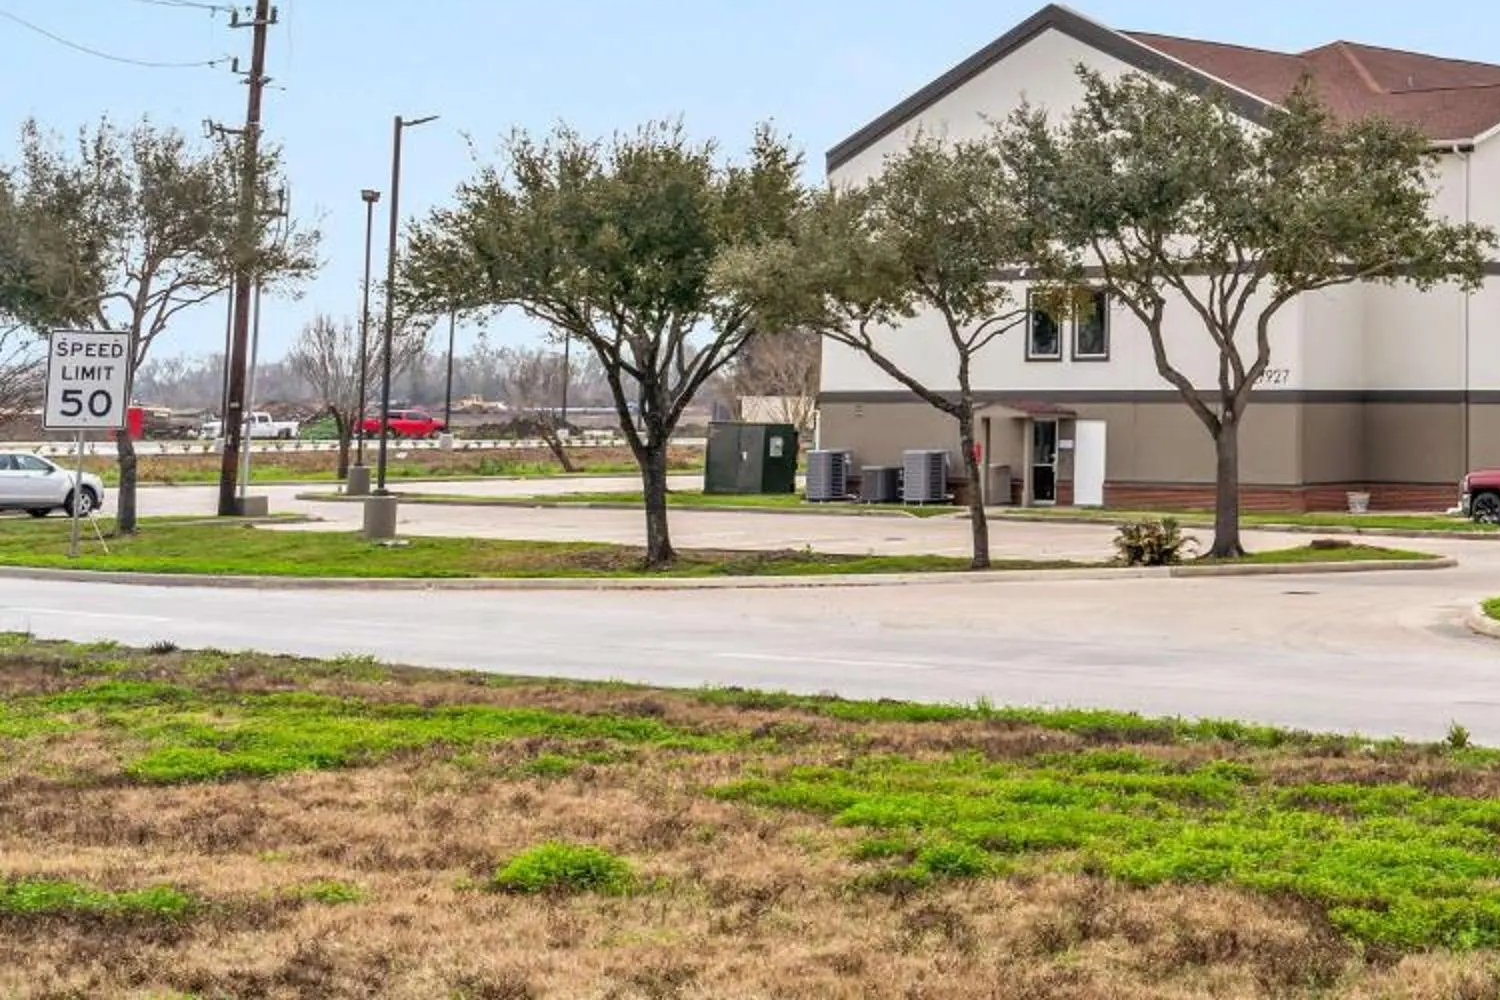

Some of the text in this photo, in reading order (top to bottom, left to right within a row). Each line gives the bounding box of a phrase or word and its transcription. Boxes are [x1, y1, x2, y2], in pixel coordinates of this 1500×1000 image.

[56, 341, 124, 358] SPEED
[61, 365, 115, 381] LIMIT
[1257, 369, 1290, 385] 927
[60, 389, 112, 417] 50
